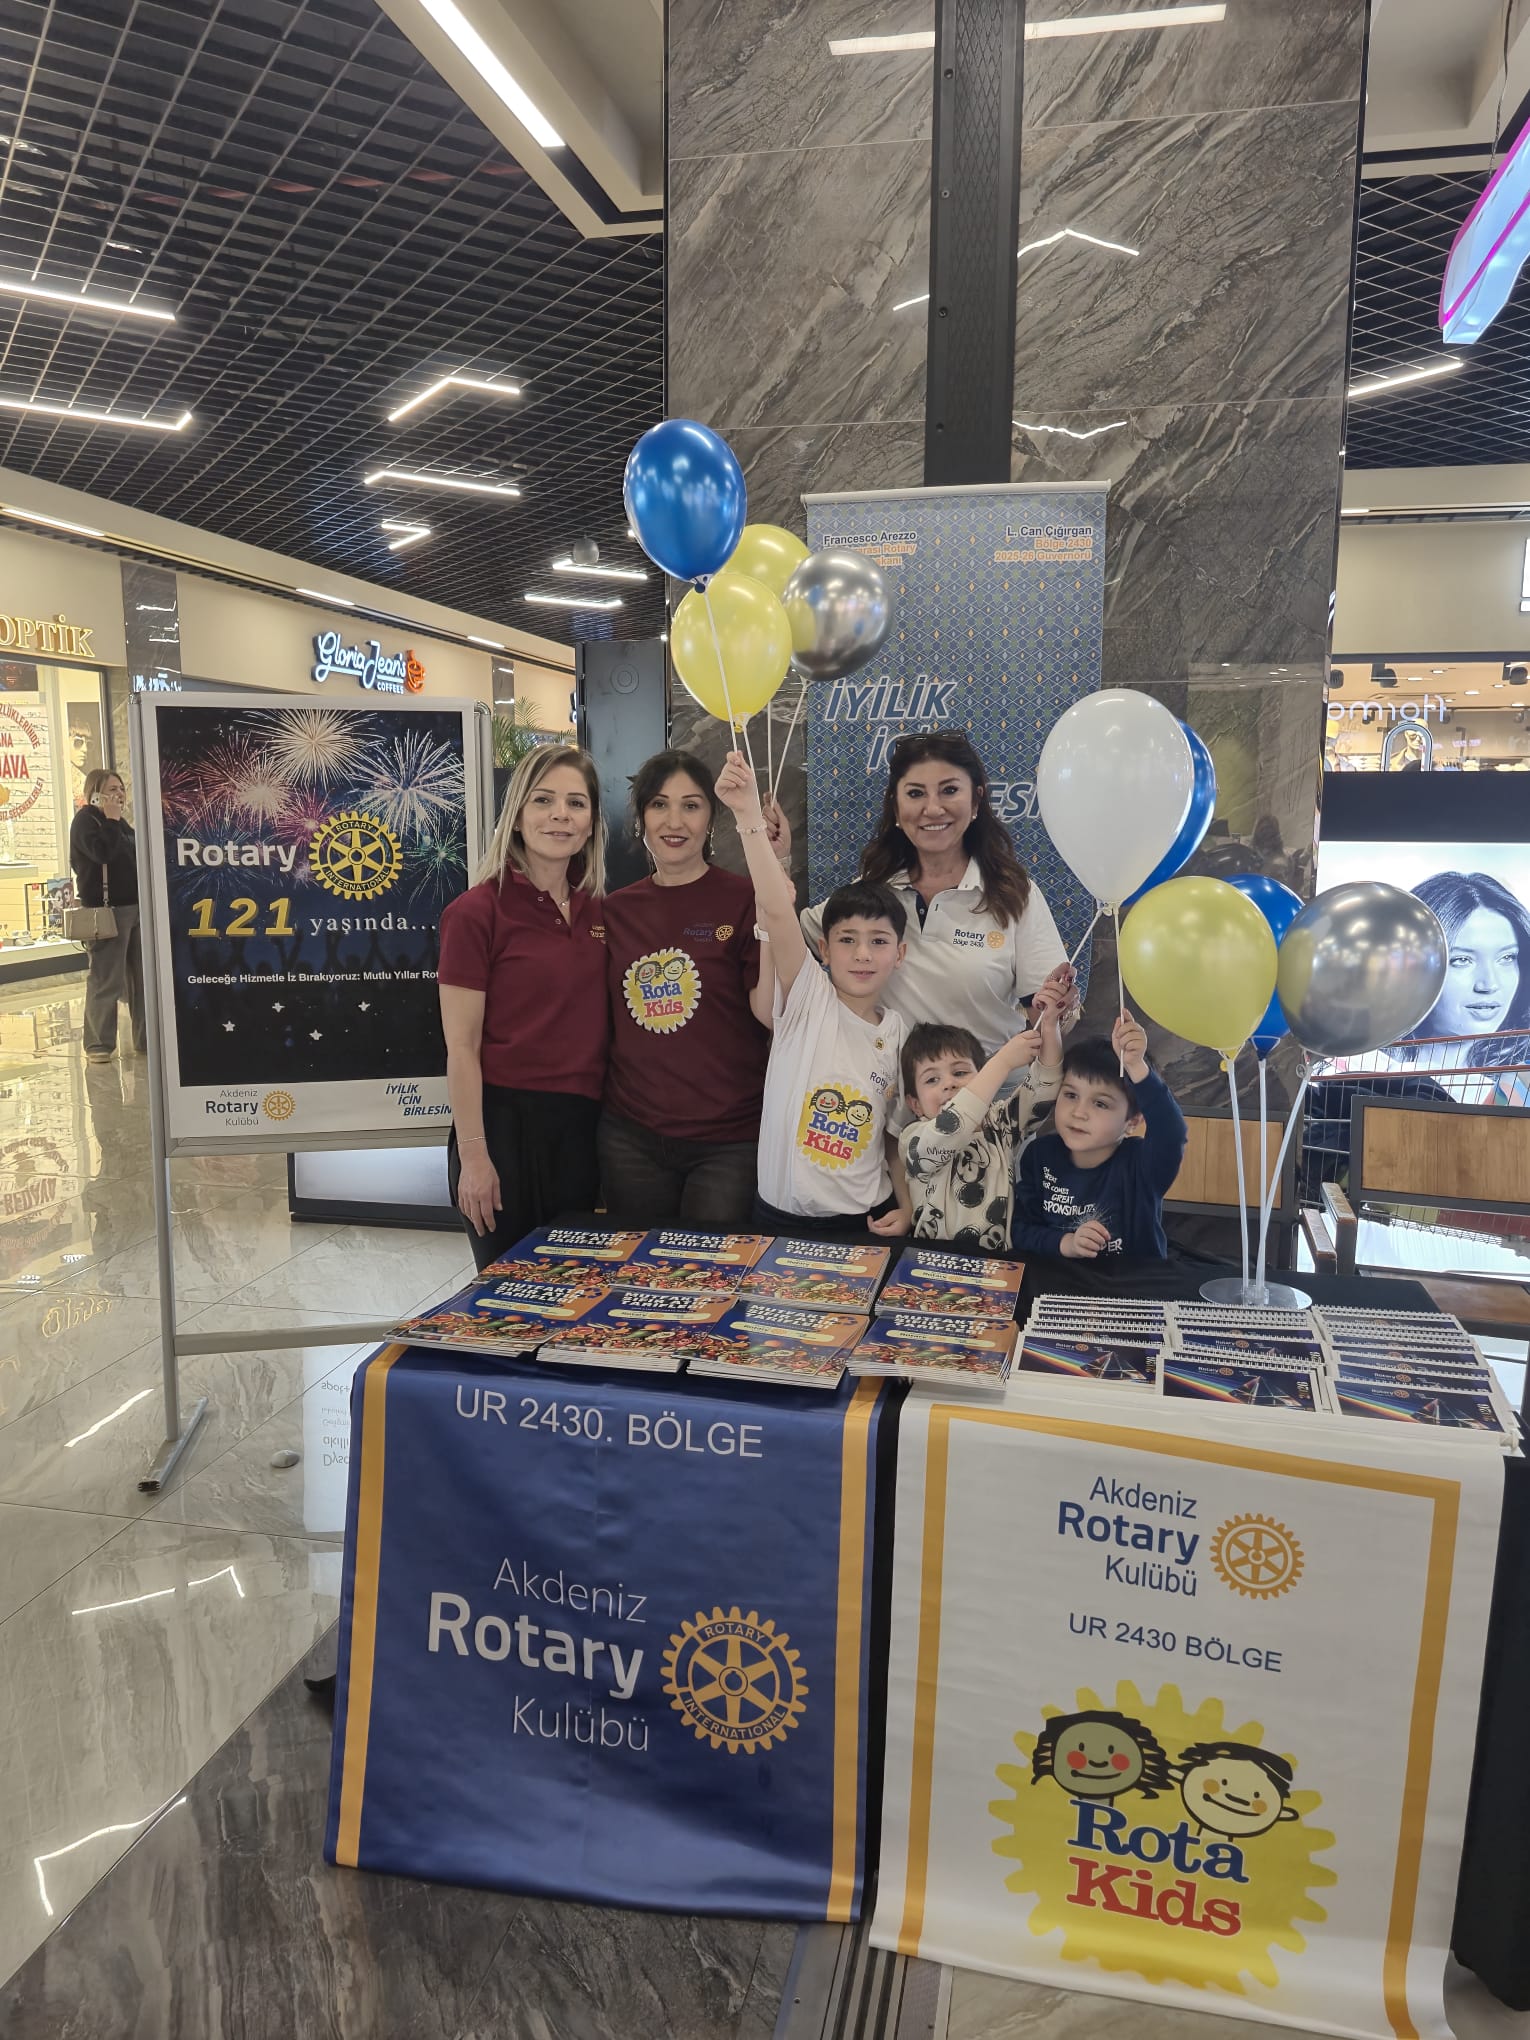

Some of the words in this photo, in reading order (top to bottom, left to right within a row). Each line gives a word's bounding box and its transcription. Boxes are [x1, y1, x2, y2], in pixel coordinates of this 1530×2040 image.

[823, 534, 878, 545] Francesco
[880, 532, 916, 542] Arezzo
[1007, 527, 1016, 536] L.
[1020, 526, 1042, 536] Can
[1035, 538, 1065, 549] Bölge
[1068, 538, 1091, 548] 2430
[883, 544, 916, 554] Rotary
[995, 552, 1034, 560] 2025-26
[0, 614, 95, 658] OPTİK
[315, 631, 366, 682] Gloria
[363, 640, 406, 689] Jean's
[377, 681, 404, 694] COFFEES
[825, 675, 955, 720] İYİLİK
[0, 753, 30, 779] AVA
[336, 822, 374, 832] ROTARY
[177, 838, 297, 872] Rotary
[326, 870, 390, 890] INTERNATIONAL
[188, 897, 296, 938] 121
[954, 929, 985, 941] Rotary
[188, 974, 237, 985] Geleceğe
[240, 973, 285, 983] Hizmetle
[287, 972, 296, 982] İz
[298, 972, 360, 983] Bırakıyoruz:
[364, 971, 392, 981] Mutlu
[394, 970, 419, 980] Yıllar
[640, 982, 682, 1000] Rota
[644, 999, 684, 1018] Kids
[220, 1088, 258, 1098] Akdeniz
[386, 1083, 419, 1094] İYİLİK
[205, 1100, 259, 1115] Rotary
[225, 1116, 259, 1126] Kulübü
[808, 1110, 859, 1142] Rota
[802, 1129, 853, 1160] Kids
[1051, 1194, 1074, 1204] GREAT
[456, 1385, 508, 1425] UR
[520, 1398, 613, 1443] 2430.
[628, 1410, 764, 1458] BÖLGE
[1089, 1476, 1198, 1519] Akdeniz
[1058, 1501, 1200, 1566] Rotary
[1105, 1555, 1198, 1597] Kulübü
[493, 1557, 649, 1624] Akdeniz
[428, 1591, 644, 1700] Rotary
[703, 1622, 768, 1643] ROTARY
[1068, 1612, 1108, 1640] UR
[1115, 1622, 1178, 1652] 2430
[1185, 1636, 1283, 1672] BÖLGE
[512, 1696, 650, 1752] Kulübü
[682, 1698, 787, 1740] INTERNATIONAL
[1066, 1800, 1250, 1884] Rota
[1066, 1856, 1242, 1937] Kids
